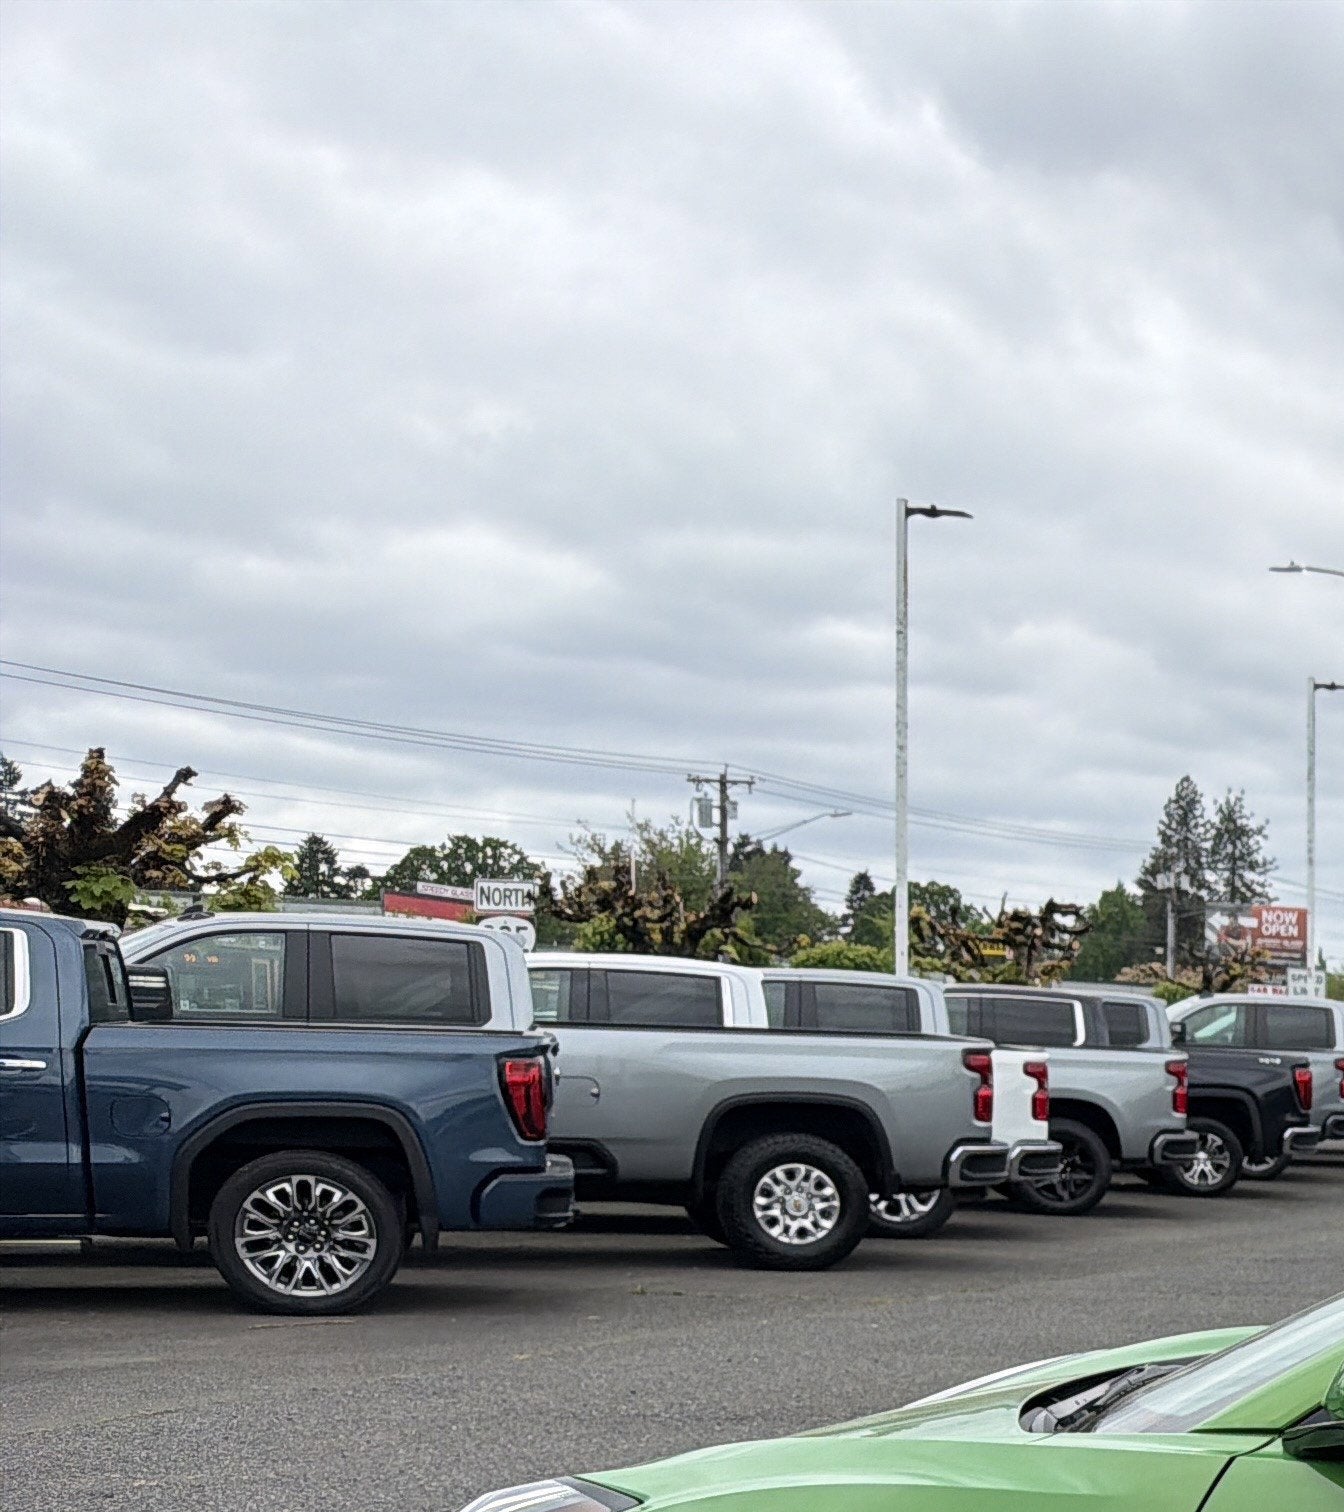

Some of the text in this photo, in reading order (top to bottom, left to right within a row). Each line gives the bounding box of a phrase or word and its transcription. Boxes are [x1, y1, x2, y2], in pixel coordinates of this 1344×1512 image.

[480, 886, 532, 907] NORTH
[1261, 909, 1298, 924] NOW
[1261, 923, 1298, 937] OPEN
[1291, 974, 1323, 985] SPED
